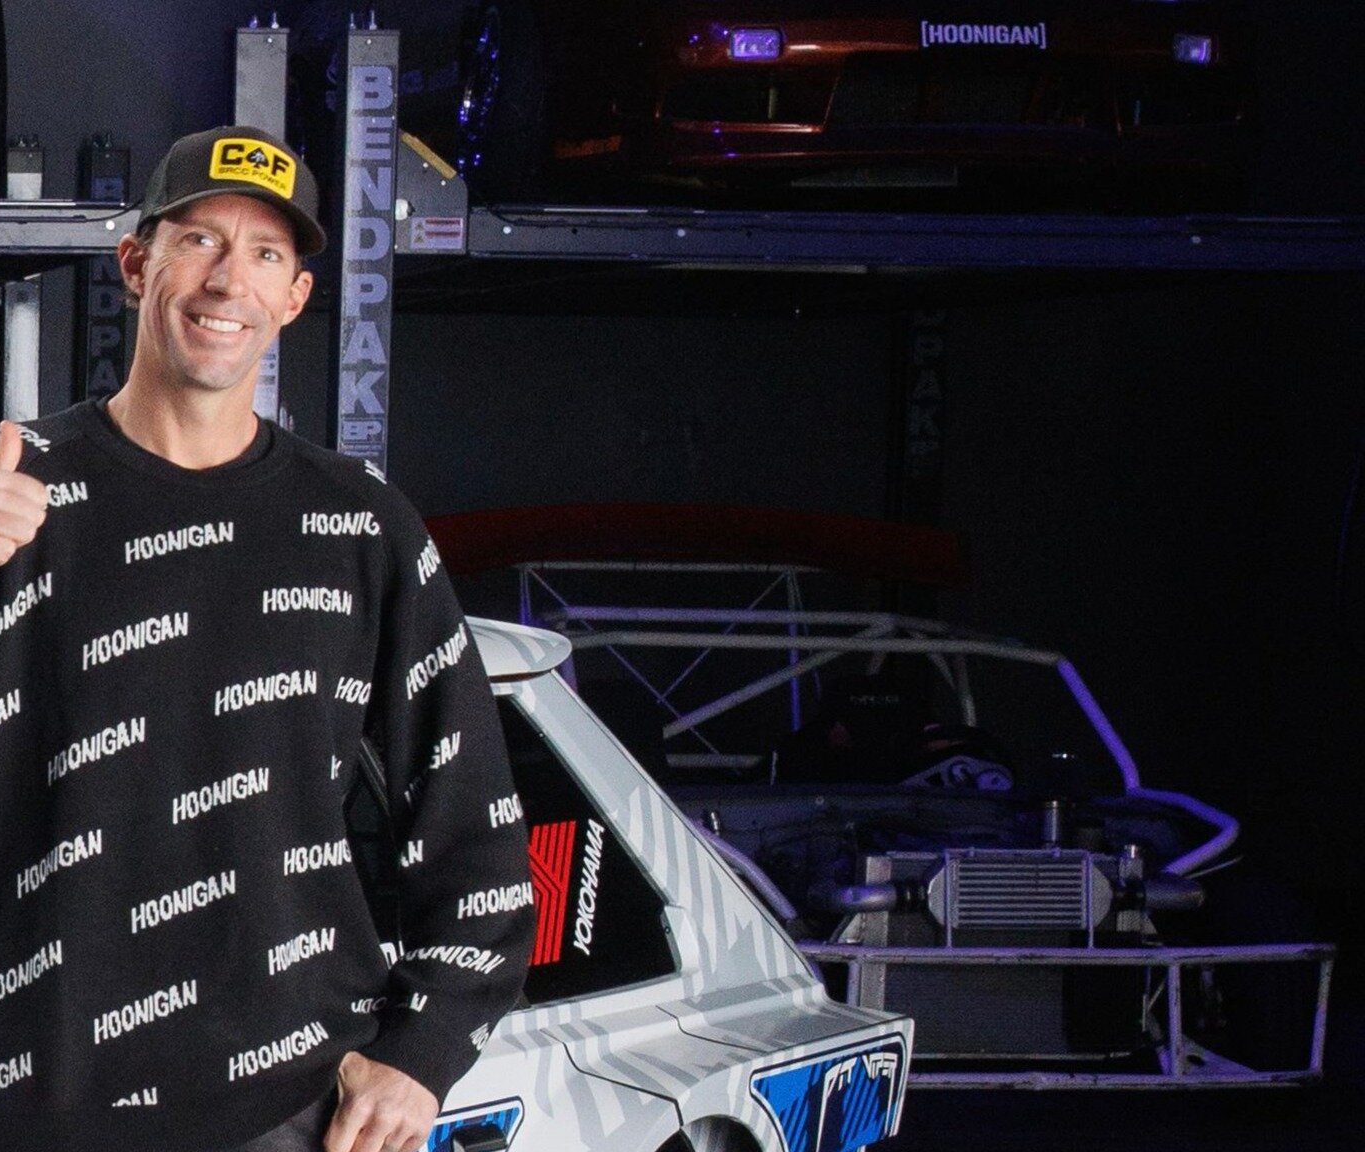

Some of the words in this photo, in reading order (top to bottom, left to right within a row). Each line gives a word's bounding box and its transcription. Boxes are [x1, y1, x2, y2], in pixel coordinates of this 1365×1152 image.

[921, 20, 1046, 50] [HOONIGAN]
[341, 65, 394, 414] BENDPAK
[125, 522, 234, 563] HOONIGAN
[302, 512, 381, 535] HOONIG
[263, 587, 352, 615] HOONIGAN
[82, 612, 189, 671] HOONIGAN
[215, 670, 317, 716] HOONIGAN
[48, 717, 145, 787] HOONIGAN
[173, 767, 269, 825] HOONIGAN
[17, 829, 102, 899] HOONIGAN
[284, 838, 352, 876] HOONIG
[132, 870, 236, 934] HOONIGAN
[573, 818, 605, 956] YOKOHAMA
[94, 980, 197, 1045] HOONIGAN
[229, 1021, 329, 1082] HOONIGAN
